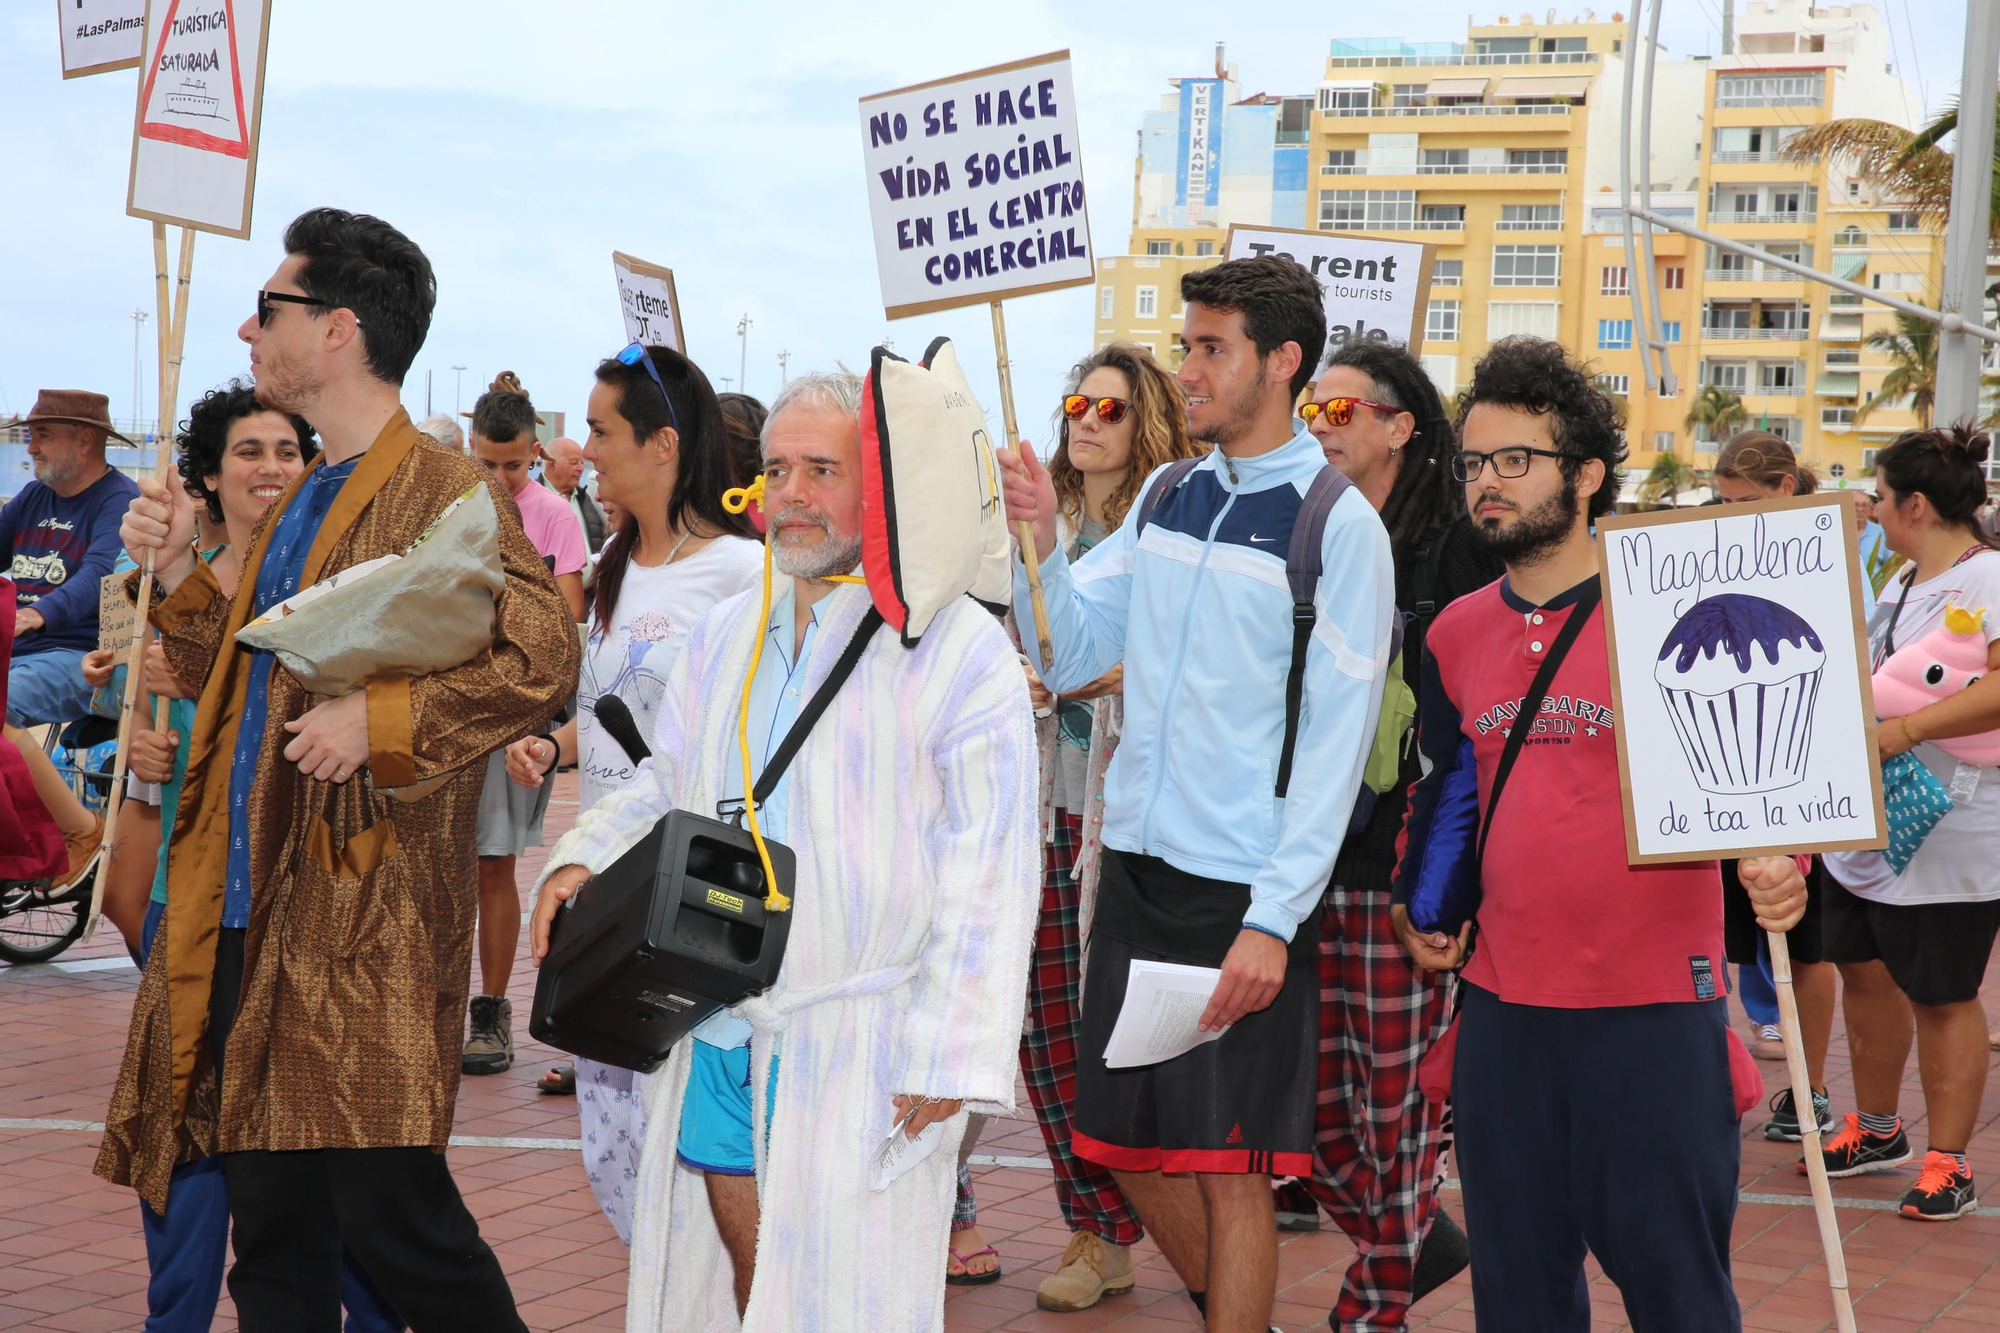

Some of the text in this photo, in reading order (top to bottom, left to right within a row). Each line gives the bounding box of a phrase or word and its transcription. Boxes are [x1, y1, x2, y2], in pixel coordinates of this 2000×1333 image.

[159, 48, 220, 72] SATURADA
[869, 78, 1058, 149] NO SE HACE
[1191, 86, 1207, 171] VERTIKAN
[964, 133, 1072, 189] SOCIAL
[896, 179, 1084, 251] EN EL CENTRO
[924, 227, 1086, 286] COMERCIAL
[1310, 255, 1398, 283] rent
[1334, 283, 1393, 302] tourists
[1329, 320, 1389, 347] ale
[1620, 513, 1834, 619] Magdalena
[103, 638, 111, 650] EL
[1474, 695, 1614, 735] NAVGARE
[1659, 781, 1859, 836] de toa la vida
